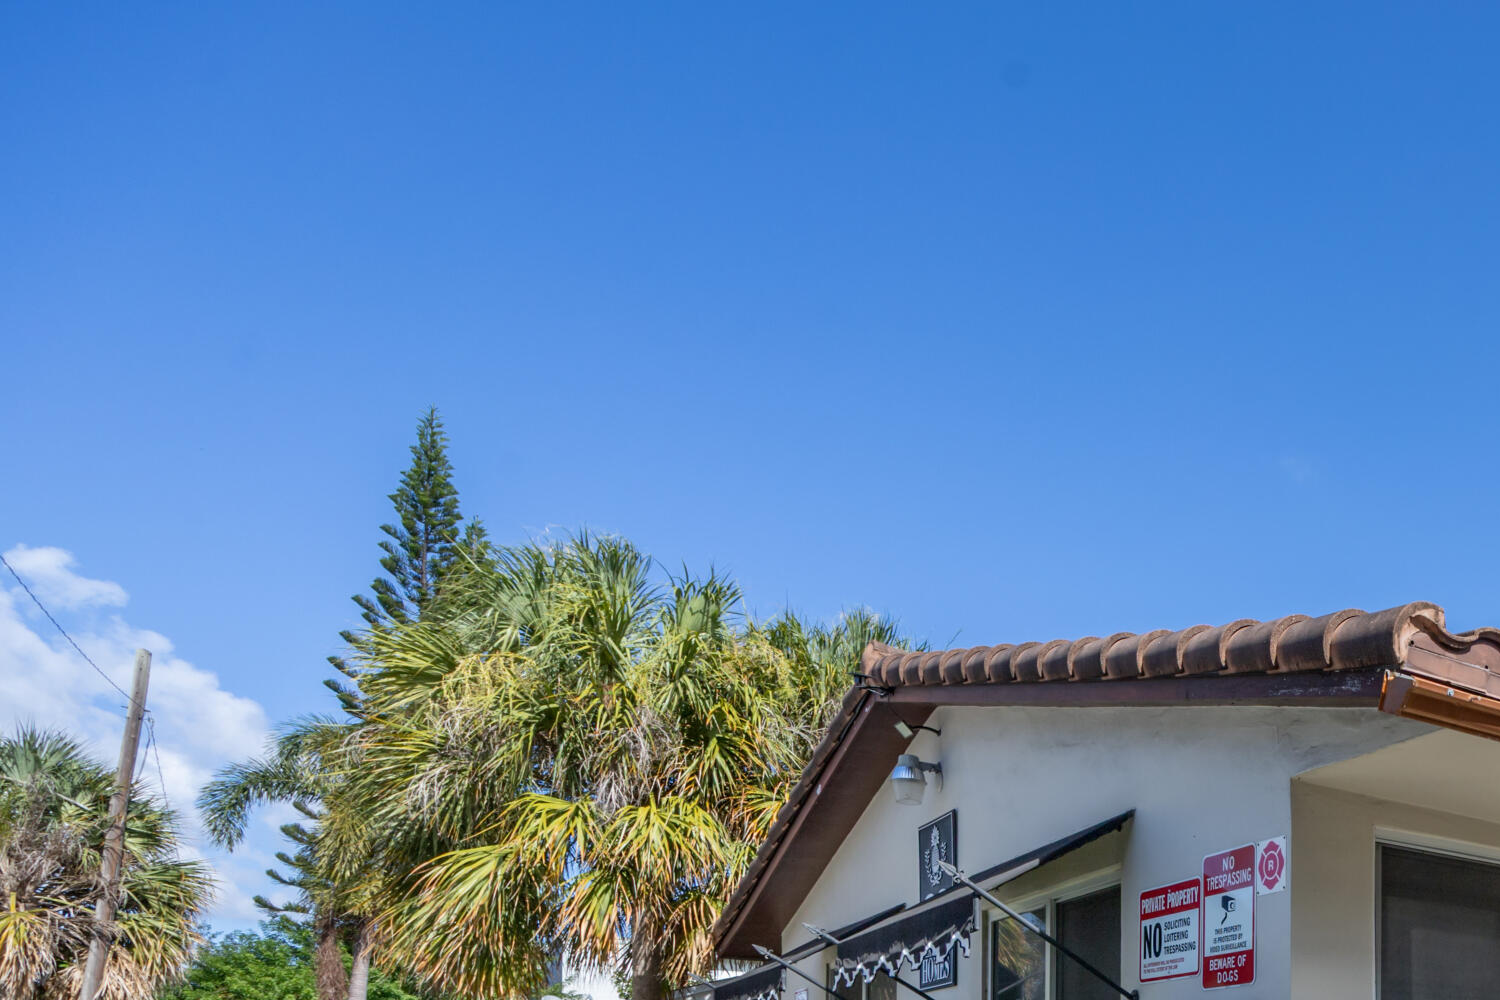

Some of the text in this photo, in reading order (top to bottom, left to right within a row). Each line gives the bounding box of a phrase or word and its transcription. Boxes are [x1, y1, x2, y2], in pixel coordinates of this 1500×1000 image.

[1222, 855, 1235, 872] NO
[1267, 859, 1274, 871] R
[1206, 867, 1252, 892] TRESPASSING
[1141, 886, 1199, 915] PRIVATE PROPERTY
[1163, 917, 1191, 931] SOLICITING
[1143, 922, 1162, 960] NO
[1163, 930, 1189, 943] LOITERING
[1163, 941, 1196, 955] TRESPASSING
[1209, 954, 1247, 972] BEWARE OF
[1216, 969, 1239, 984] DOGS
